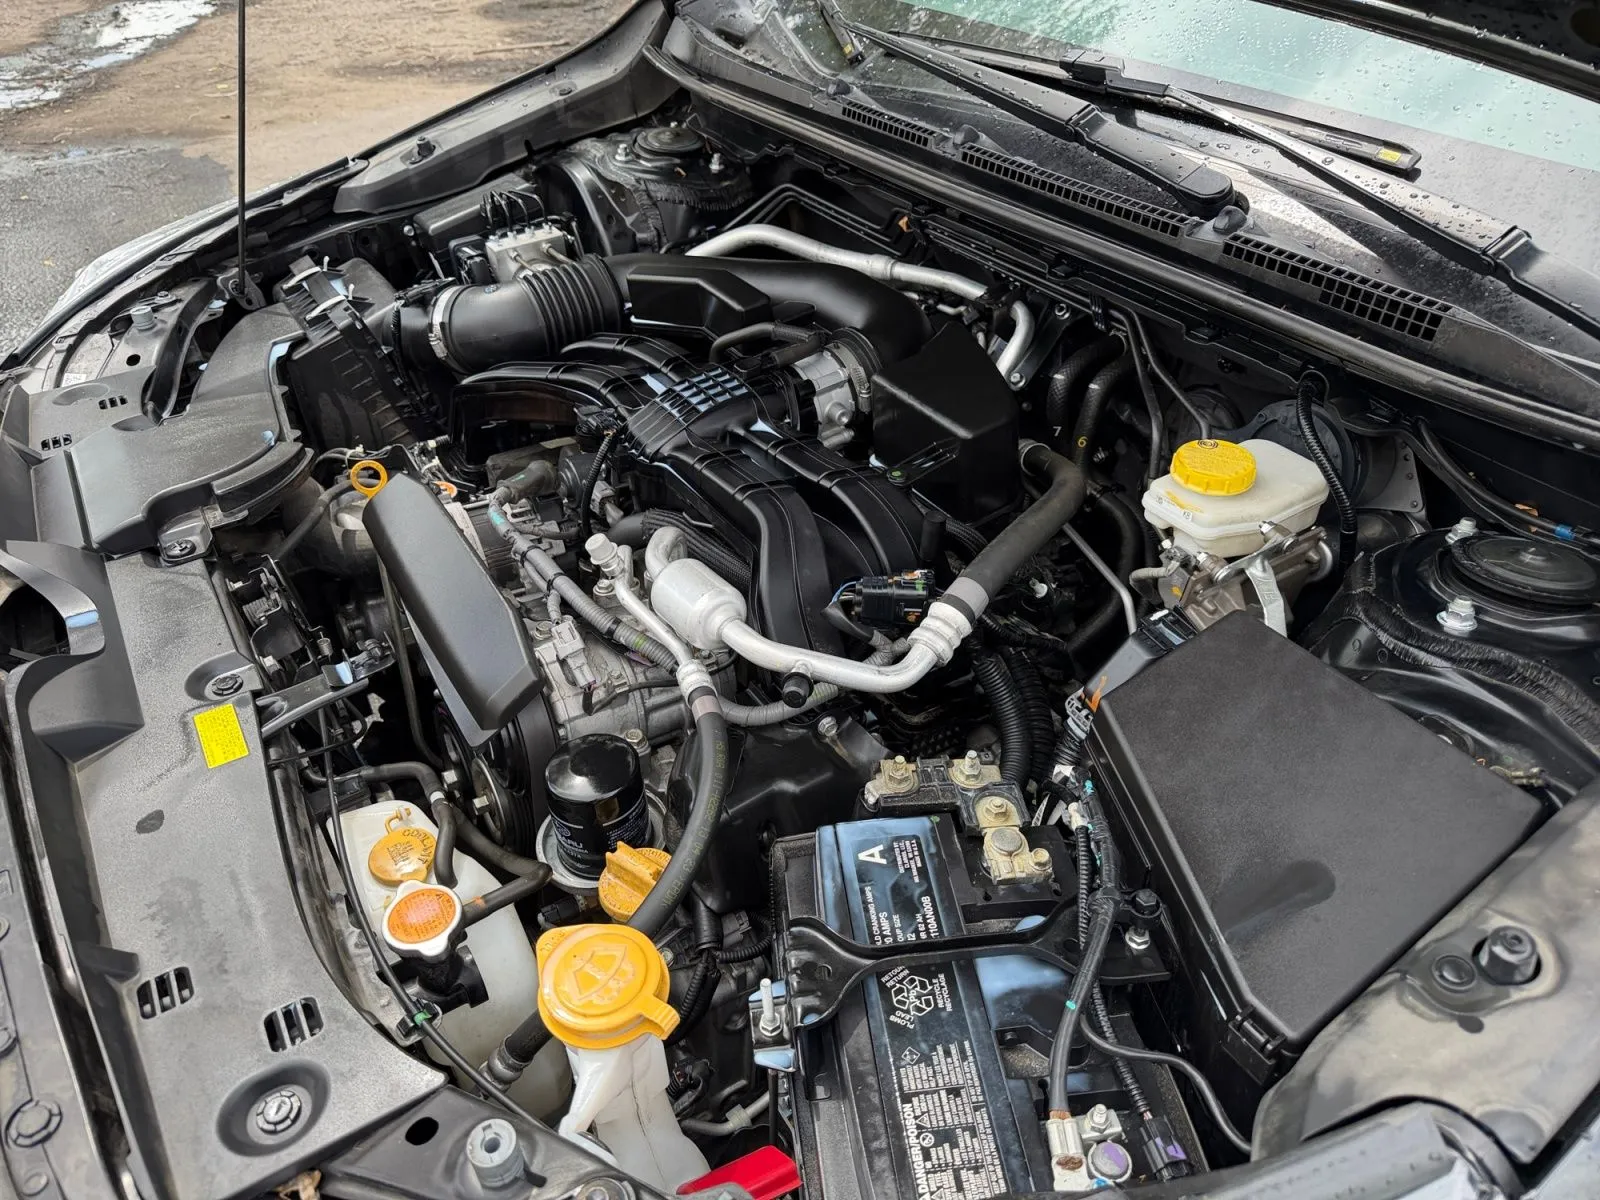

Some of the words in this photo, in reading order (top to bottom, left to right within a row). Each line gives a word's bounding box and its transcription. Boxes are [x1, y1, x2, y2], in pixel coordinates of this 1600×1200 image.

[1053, 426, 1062, 436] 7
[1078, 436, 1088, 448] 6
[858, 844, 887, 864] A
[864, 886, 874, 903] AMPS
[868, 903, 880, 935] CRANKING
[878, 912, 892, 935] AMPS
[892, 914, 901, 928] SIZE
[916, 913, 923, 923] AH
[886, 969, 910, 988] RETURN
[909, 990, 918, 1002] Pb
[932, 978, 944, 1008] RECYCLE
[938, 973, 952, 1011] RECYCLAGE
[889, 1015, 914, 1029] PLOMB
[896, 1011, 914, 1021] LEAD
[902, 1104, 929, 1194] DANGER/POISON
